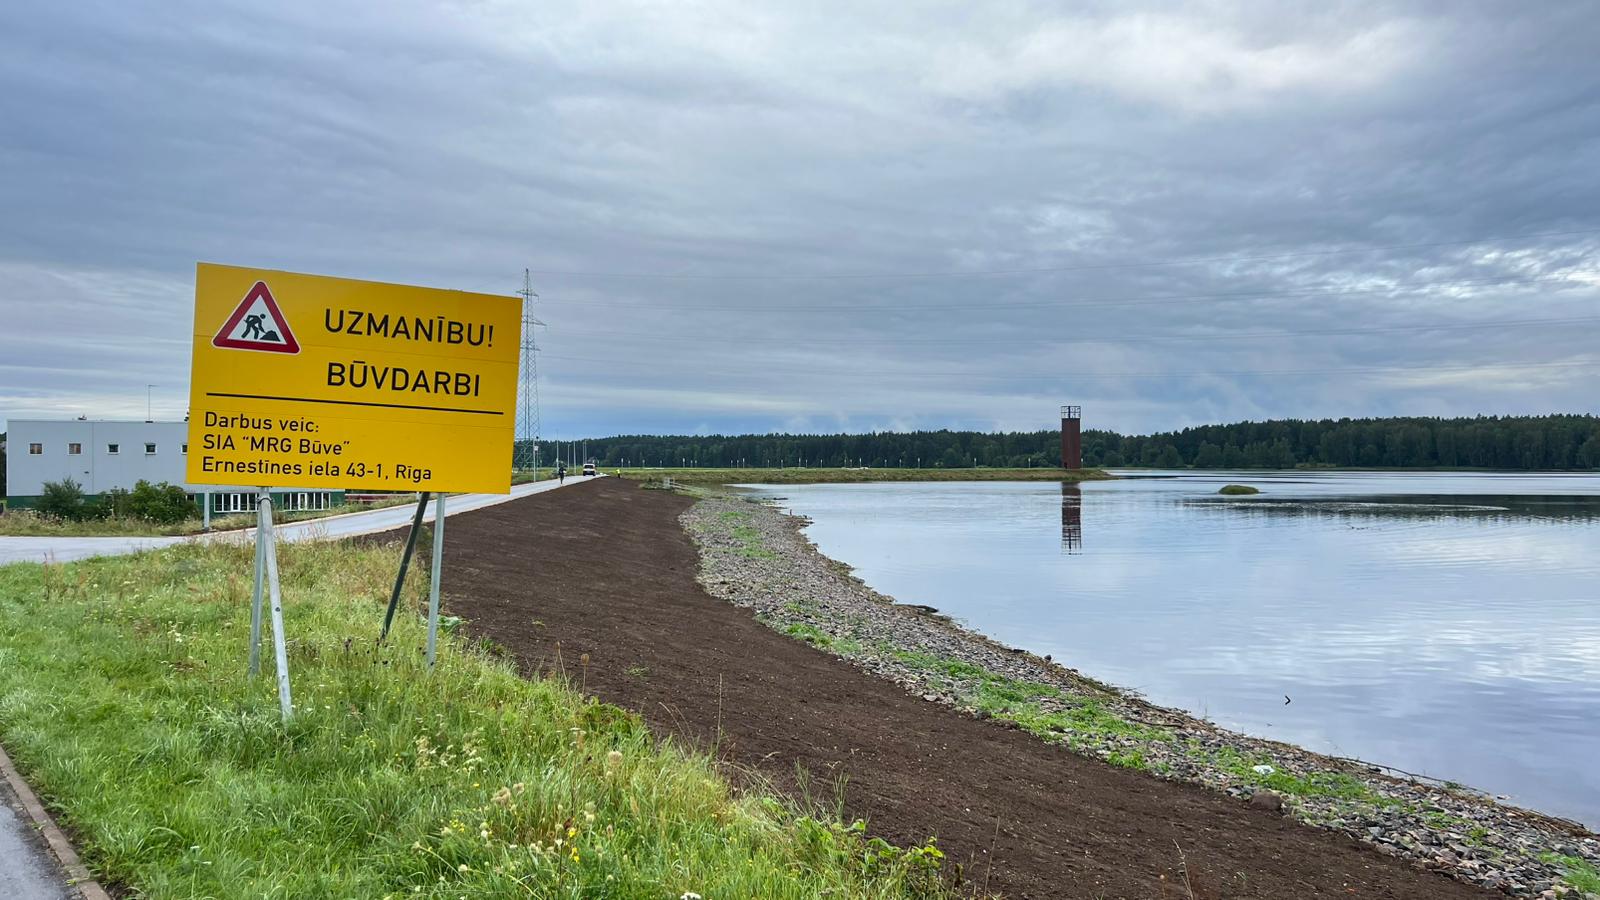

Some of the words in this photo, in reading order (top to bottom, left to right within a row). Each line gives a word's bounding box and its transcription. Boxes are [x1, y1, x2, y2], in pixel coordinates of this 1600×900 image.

[325, 308, 494, 347] UZMANĪBU!
[328, 360, 479, 396] BŪVDARBI
[205, 412, 272, 429] Darbus
[279, 417, 318, 432] veic:
[203, 434, 235, 450] SIA
[203, 456, 302, 475] Ernestīnes
[310, 461, 339, 476] iela
[346, 463, 388, 479] 43-1,
[396, 465, 431, 483] Rīga
